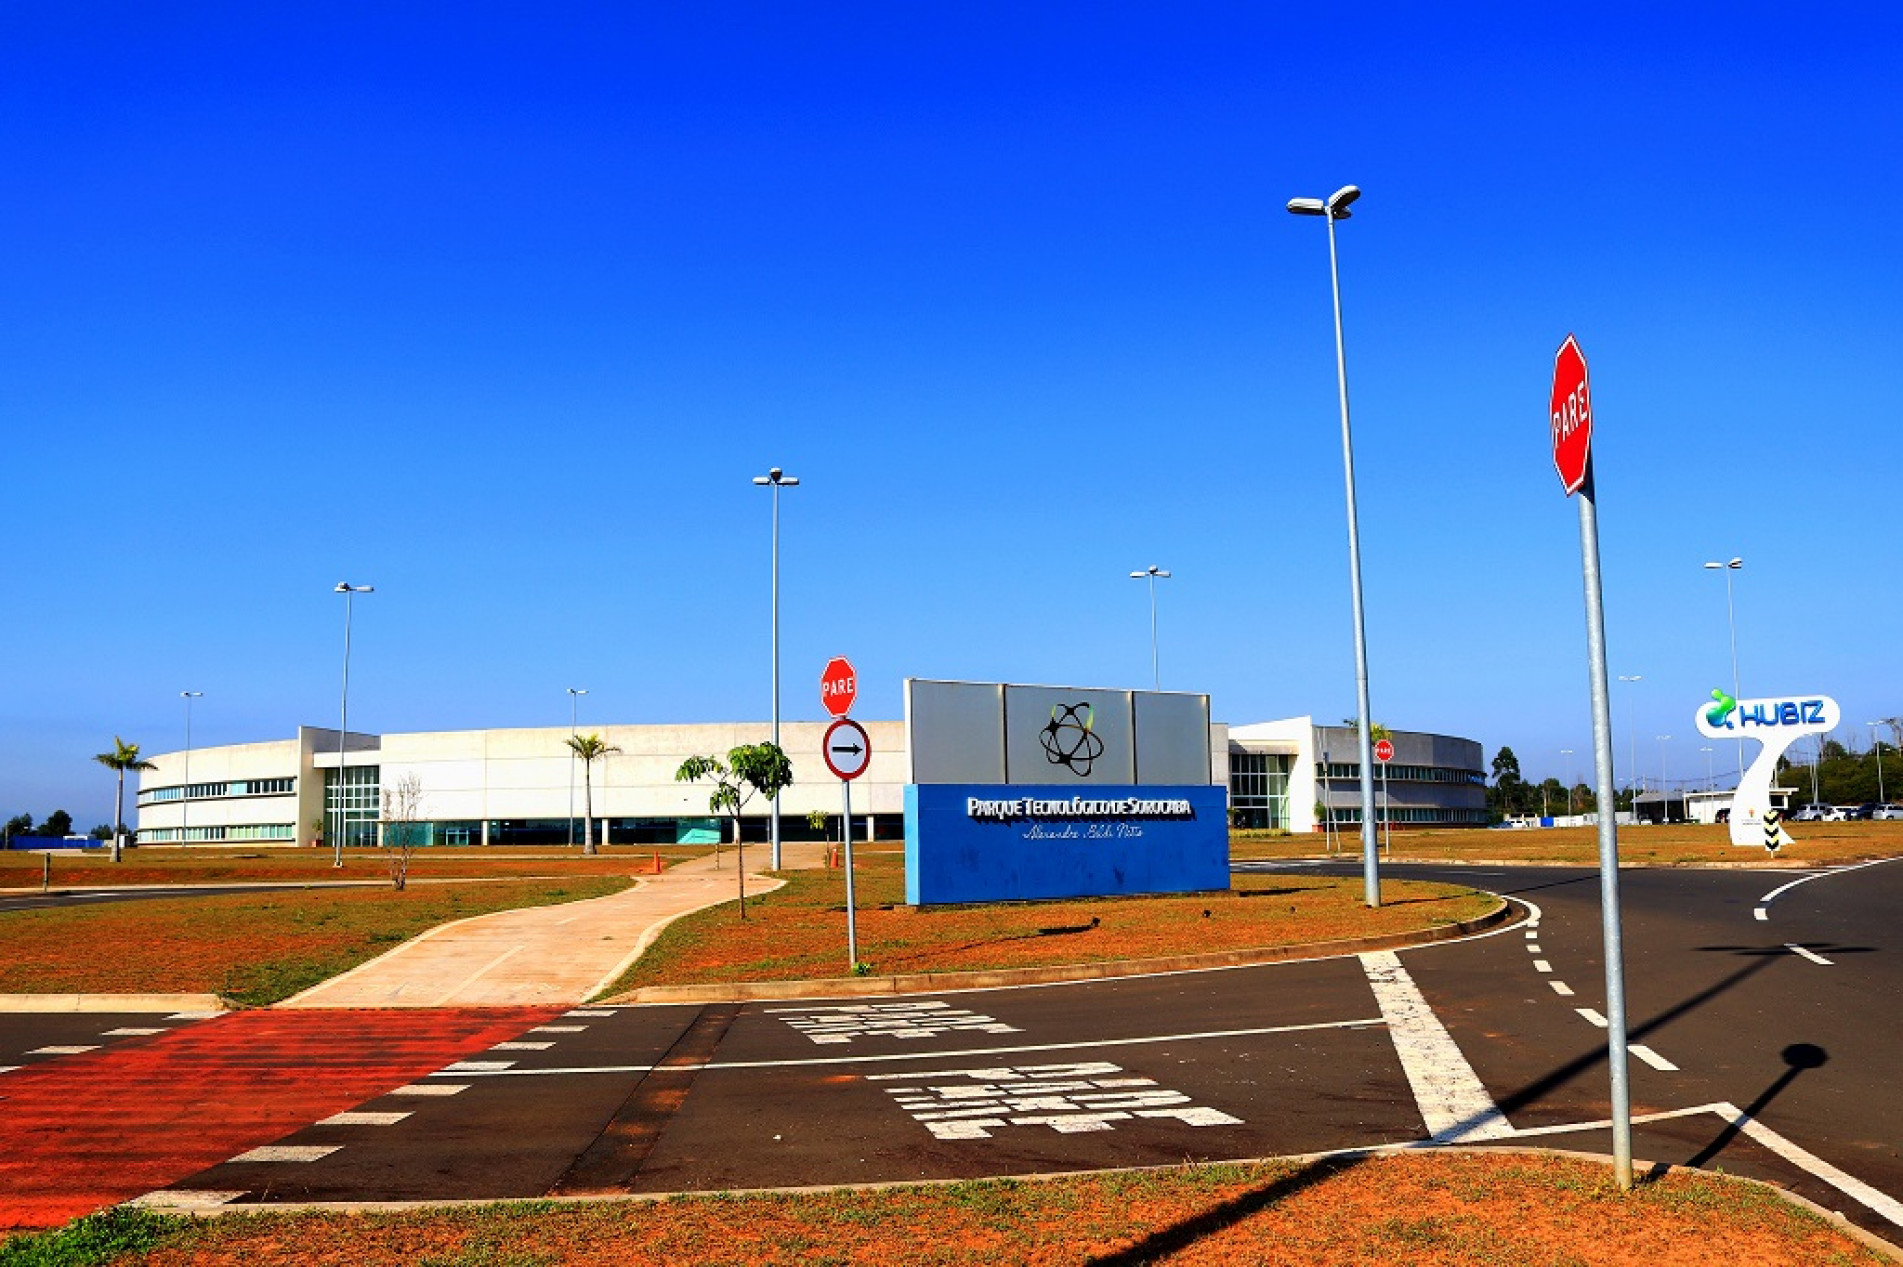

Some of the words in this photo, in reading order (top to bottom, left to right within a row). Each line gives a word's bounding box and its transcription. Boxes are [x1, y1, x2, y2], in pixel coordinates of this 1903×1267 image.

[1553, 381, 1587, 448] PARE
[822, 677, 853, 697] PARE
[1739, 700, 1825, 727] HUBIZ
[1375, 747, 1391, 755] PARE
[967, 796, 1022, 819] PARQUE
[1110, 800, 1128, 814] DE
[1128, 796, 1192, 814] SOROCABA
[1022, 824, 1079, 840] Alexandre
[763, 1001, 1026, 1045] PARE
[863, 1061, 1247, 1139] PARE
